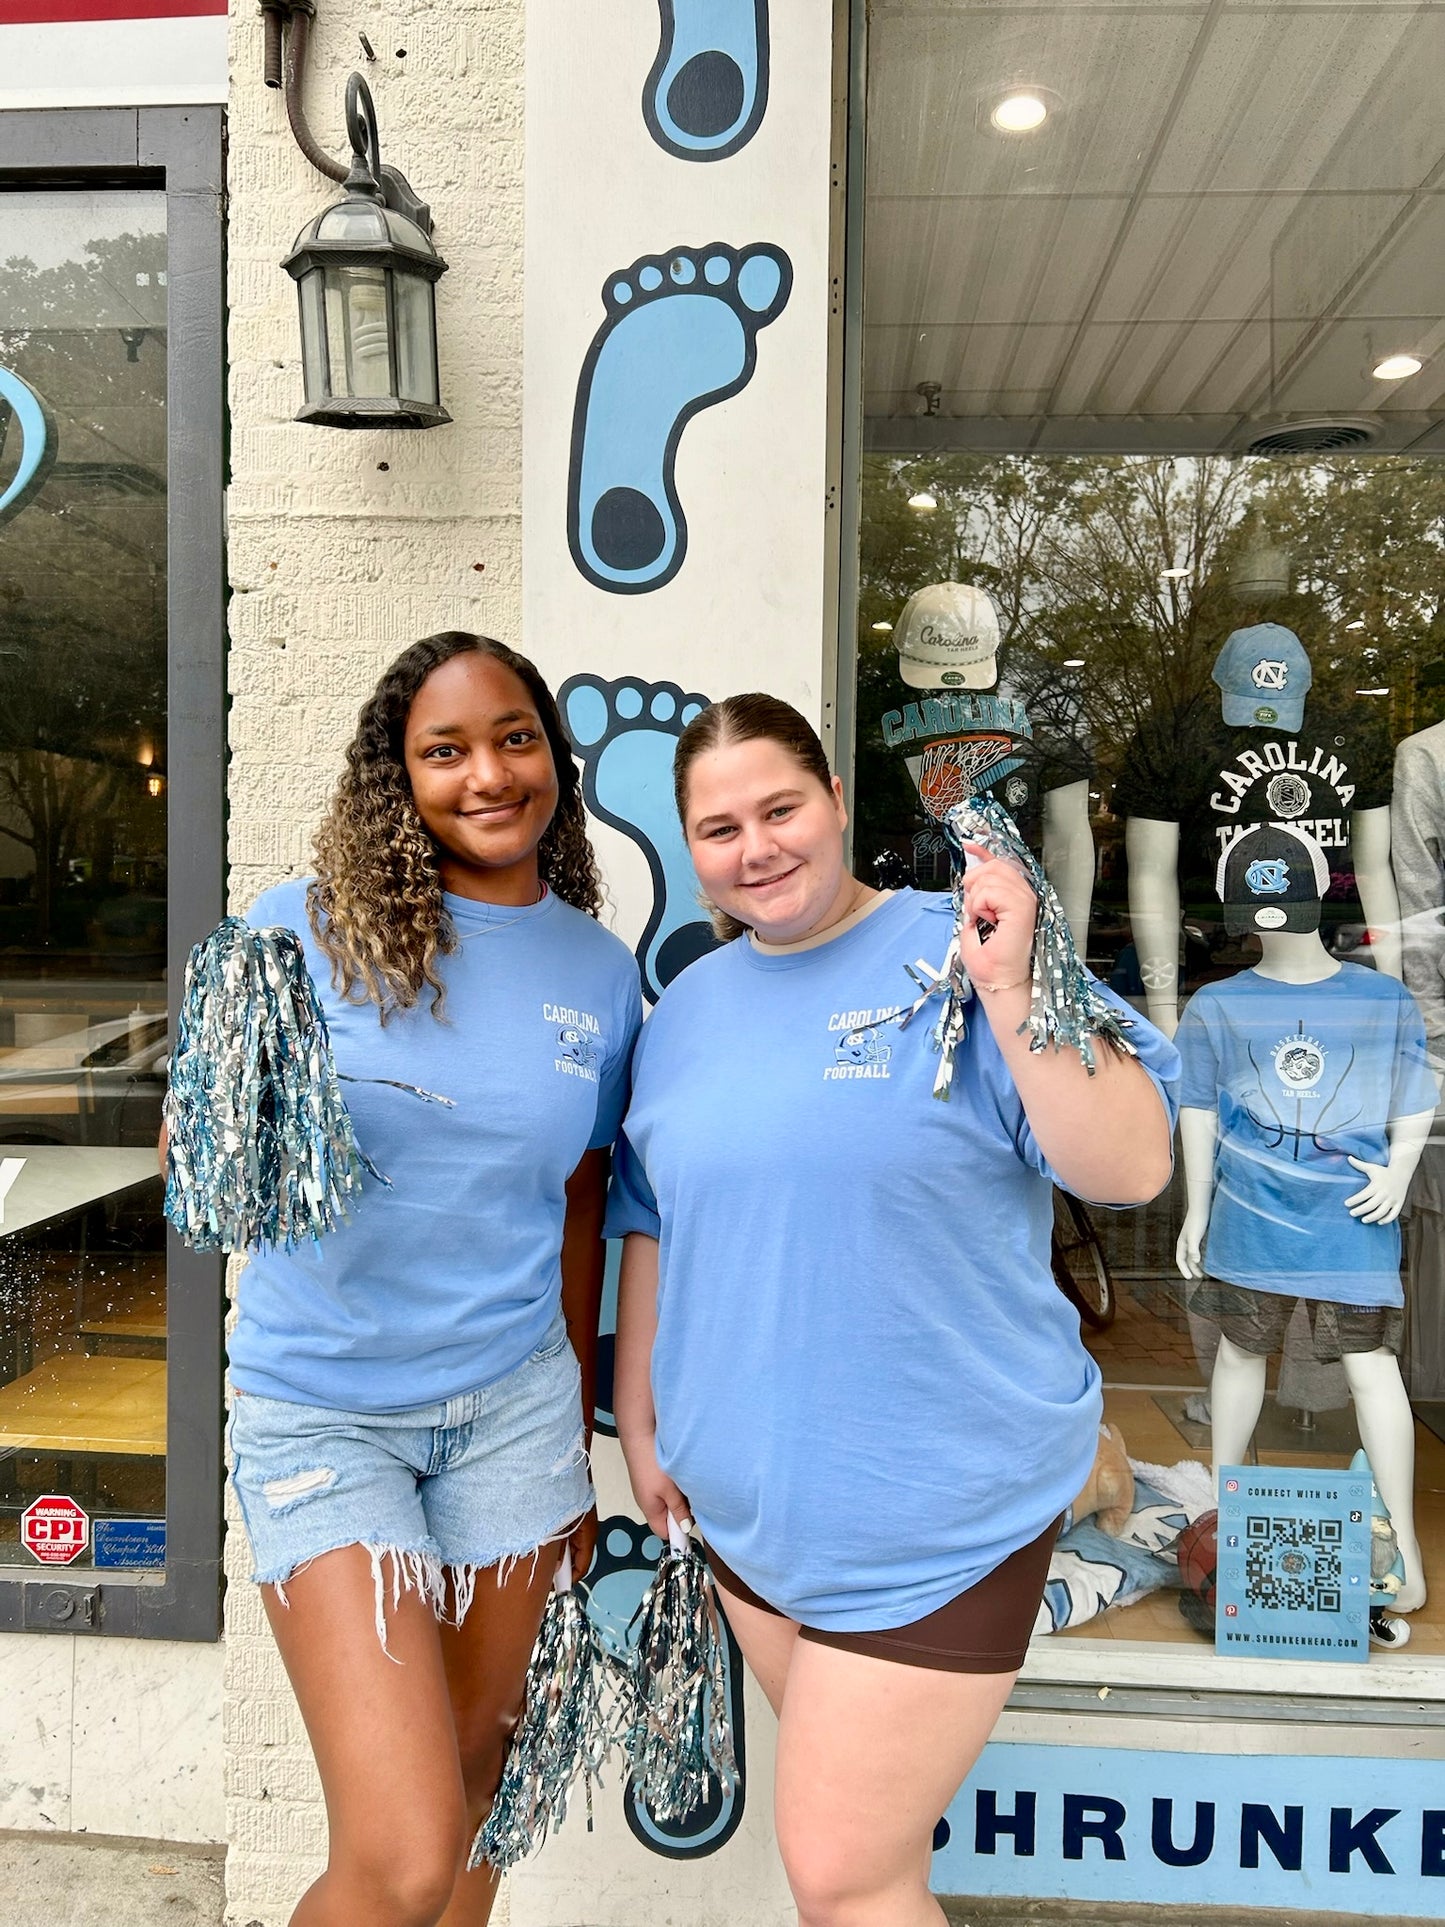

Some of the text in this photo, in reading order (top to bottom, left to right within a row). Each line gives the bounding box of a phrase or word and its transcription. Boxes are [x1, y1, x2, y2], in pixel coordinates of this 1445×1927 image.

[920, 625, 979, 647] Carolina
[881, 694, 1034, 748] CAROLINA
[1210, 741, 1355, 814] CAROLINA
[543, 1003, 601, 1036] CAROLINA
[827, 1006, 906, 1031] CAROLINA
[1269, 1034, 1329, 1057] BASKETBALL
[554, 1059, 597, 1083] FOOTBALL
[823, 1064, 891, 1081] FOOTBALL
[1282, 1089, 1295, 1098] TAR
[1247, 1488, 1338, 1500] CONNECT WITH US
[35, 1508, 77, 1517] WARNING
[28, 1519, 83, 1541] CPI
[36, 1542, 75, 1552] SECURITY
[1226, 1633, 1359, 1648] WWW.SHRUNKENHEAD.COM
